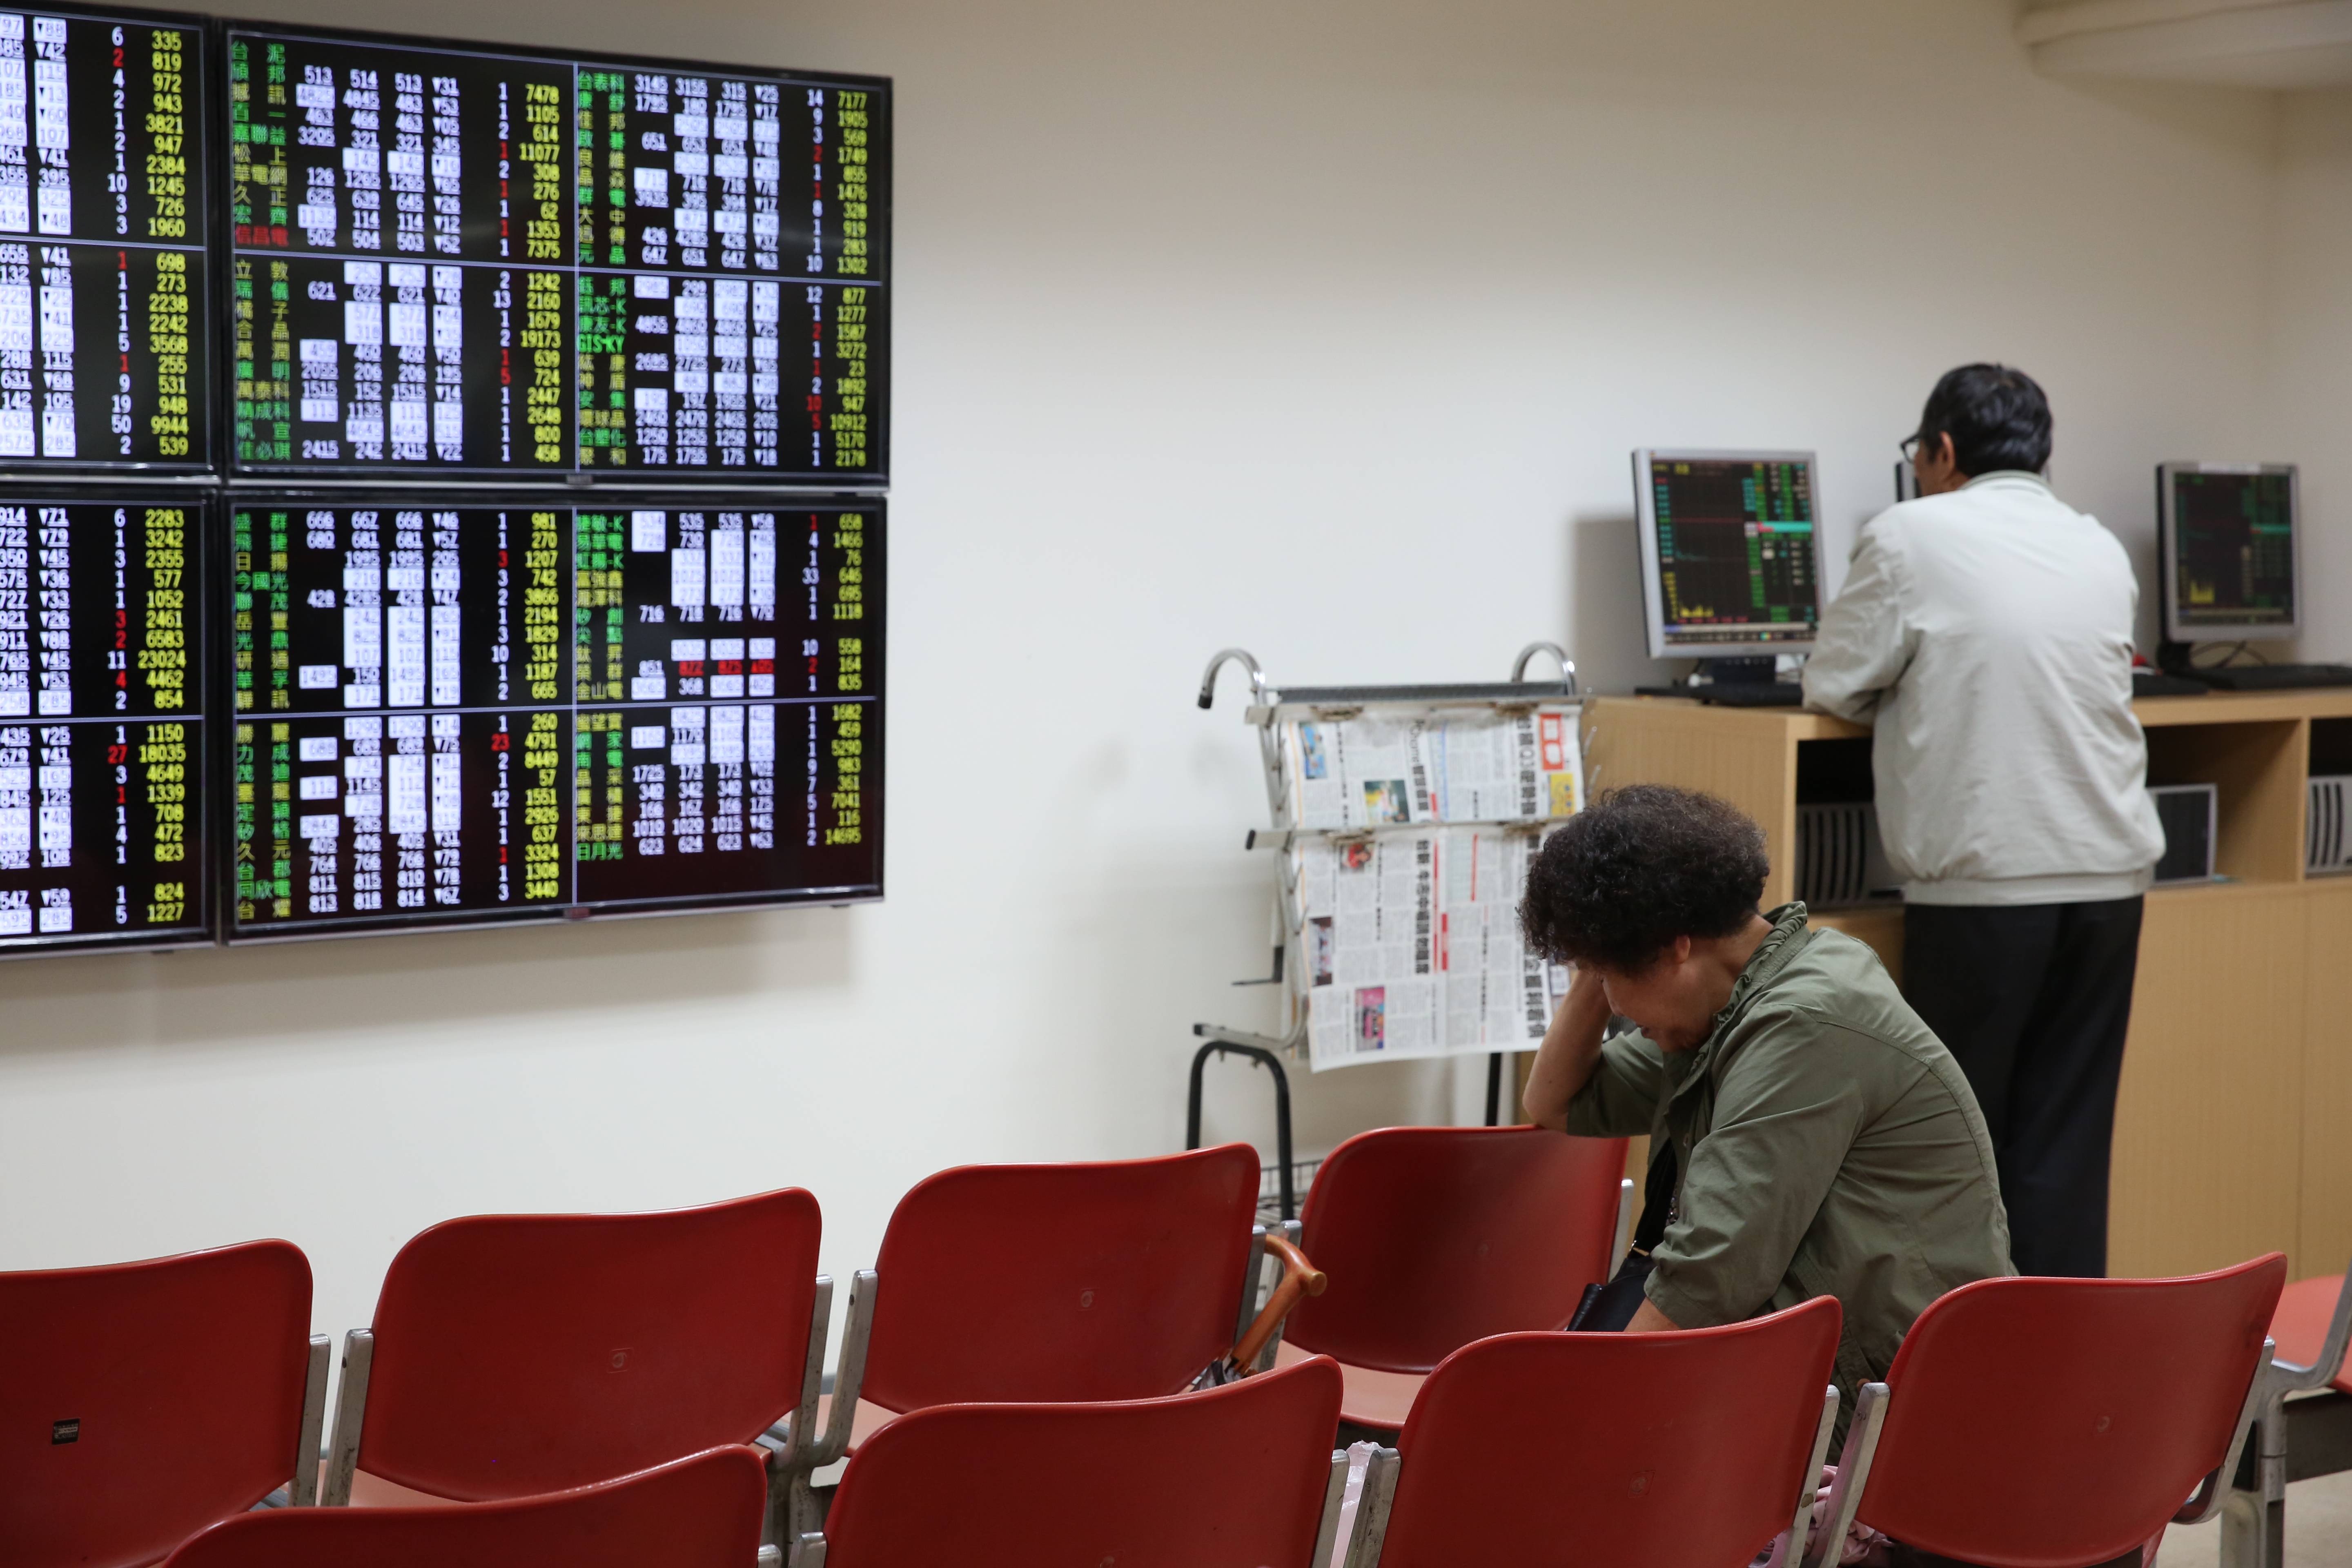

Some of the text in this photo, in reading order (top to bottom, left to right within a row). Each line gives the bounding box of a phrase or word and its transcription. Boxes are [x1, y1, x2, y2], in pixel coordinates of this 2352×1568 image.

[112, 27, 181, 51] 6 335
[153, 52, 181, 71] 819
[113, 69, 181, 93] 4 972
[305, 65, 559, 104] 513 514 7478
[154, 94, 182, 113] 943
[527, 105, 559, 123] 1105
[147, 114, 183, 134] 3821
[533, 124, 559, 143] 614
[154, 135, 182, 154] 947
[298, 126, 560, 162] 3205 321 345 11077
[147, 155, 186, 175] 2384
[108, 174, 127, 192] 10
[149, 176, 185, 196] 1245
[307, 167, 335, 186] 126
[534, 182, 559, 200] 276
[157, 196, 185, 216] 726
[541, 202, 558, 220] 62
[149, 218, 185, 237] 1960
[528, 221, 560, 239] 1353
[236, 225, 560, 258] 信昌電 502 504 7375
[157, 253, 185, 272] 698
[157, 273, 186, 292] 273
[528, 273, 560, 291] 1242
[150, 294, 188, 313] 2238
[308, 281, 560, 310] 621 622 13 2160
[150, 314, 187, 333] 2242
[528, 312, 560, 329] 1679
[151, 334, 188, 354] 3568
[521, 330, 561, 348] 19173
[577, 334, 625, 354] GIS-KY
[159, 355, 187, 374] 255
[535, 350, 560, 367] 639
[119, 374, 186, 394] 9 531
[536, 368, 560, 386] 724
[237, 380, 560, 404] 萬泰科 2447
[112, 394, 187, 414] 19 948
[111, 414, 189, 434] 50 9944
[160, 436, 188, 455] 539
[302, 440, 339, 459] 2415
[146, 510, 184, 527] 2283
[351, 511, 379, 530] 667
[146, 530, 183, 548] 3242
[532, 531, 557, 548] 270
[147, 550, 184, 568] 2355
[526, 550, 558, 568] 1207
[154, 570, 182, 588] 577
[235, 569, 557, 591] 今國光 742
[147, 590, 183, 608] 1052
[147, 610, 183, 628] 2461
[525, 607, 558, 624] 2194
[147, 630, 184, 648] 6583
[108, 650, 186, 669] 11 23024
[492, 645, 558, 662] 10 314
[147, 670, 183, 688] 4462
[155, 690, 184, 708] 854
[532, 681, 557, 699] 665
[532, 713, 557, 731] 260
[148, 724, 184, 742] 1150
[492, 732, 557, 750] 23 4791
[109, 744, 186, 763] 27 18035
[147, 764, 184, 782] 4649
[540, 769, 556, 786] 57
[149, 784, 185, 802] 1339
[492, 788, 557, 808] 12 1551
[156, 804, 184, 822] 708
[525, 806, 559, 824] 2926
[155, 823, 183, 841] 472
[532, 824, 557, 842] 637
[155, 843, 184, 862] 823
[525, 843, 559, 862] 3324
[577, 842, 623, 860] 日月光
[155, 883, 184, 901] 824
[237, 879, 291, 900] 同欣電
[309, 875, 338, 893] 811
[354, 873, 381, 891] 815
[309, 894, 338, 913] 813
[526, 880, 558, 899] 3440
[149, 902, 184, 922] 1227
